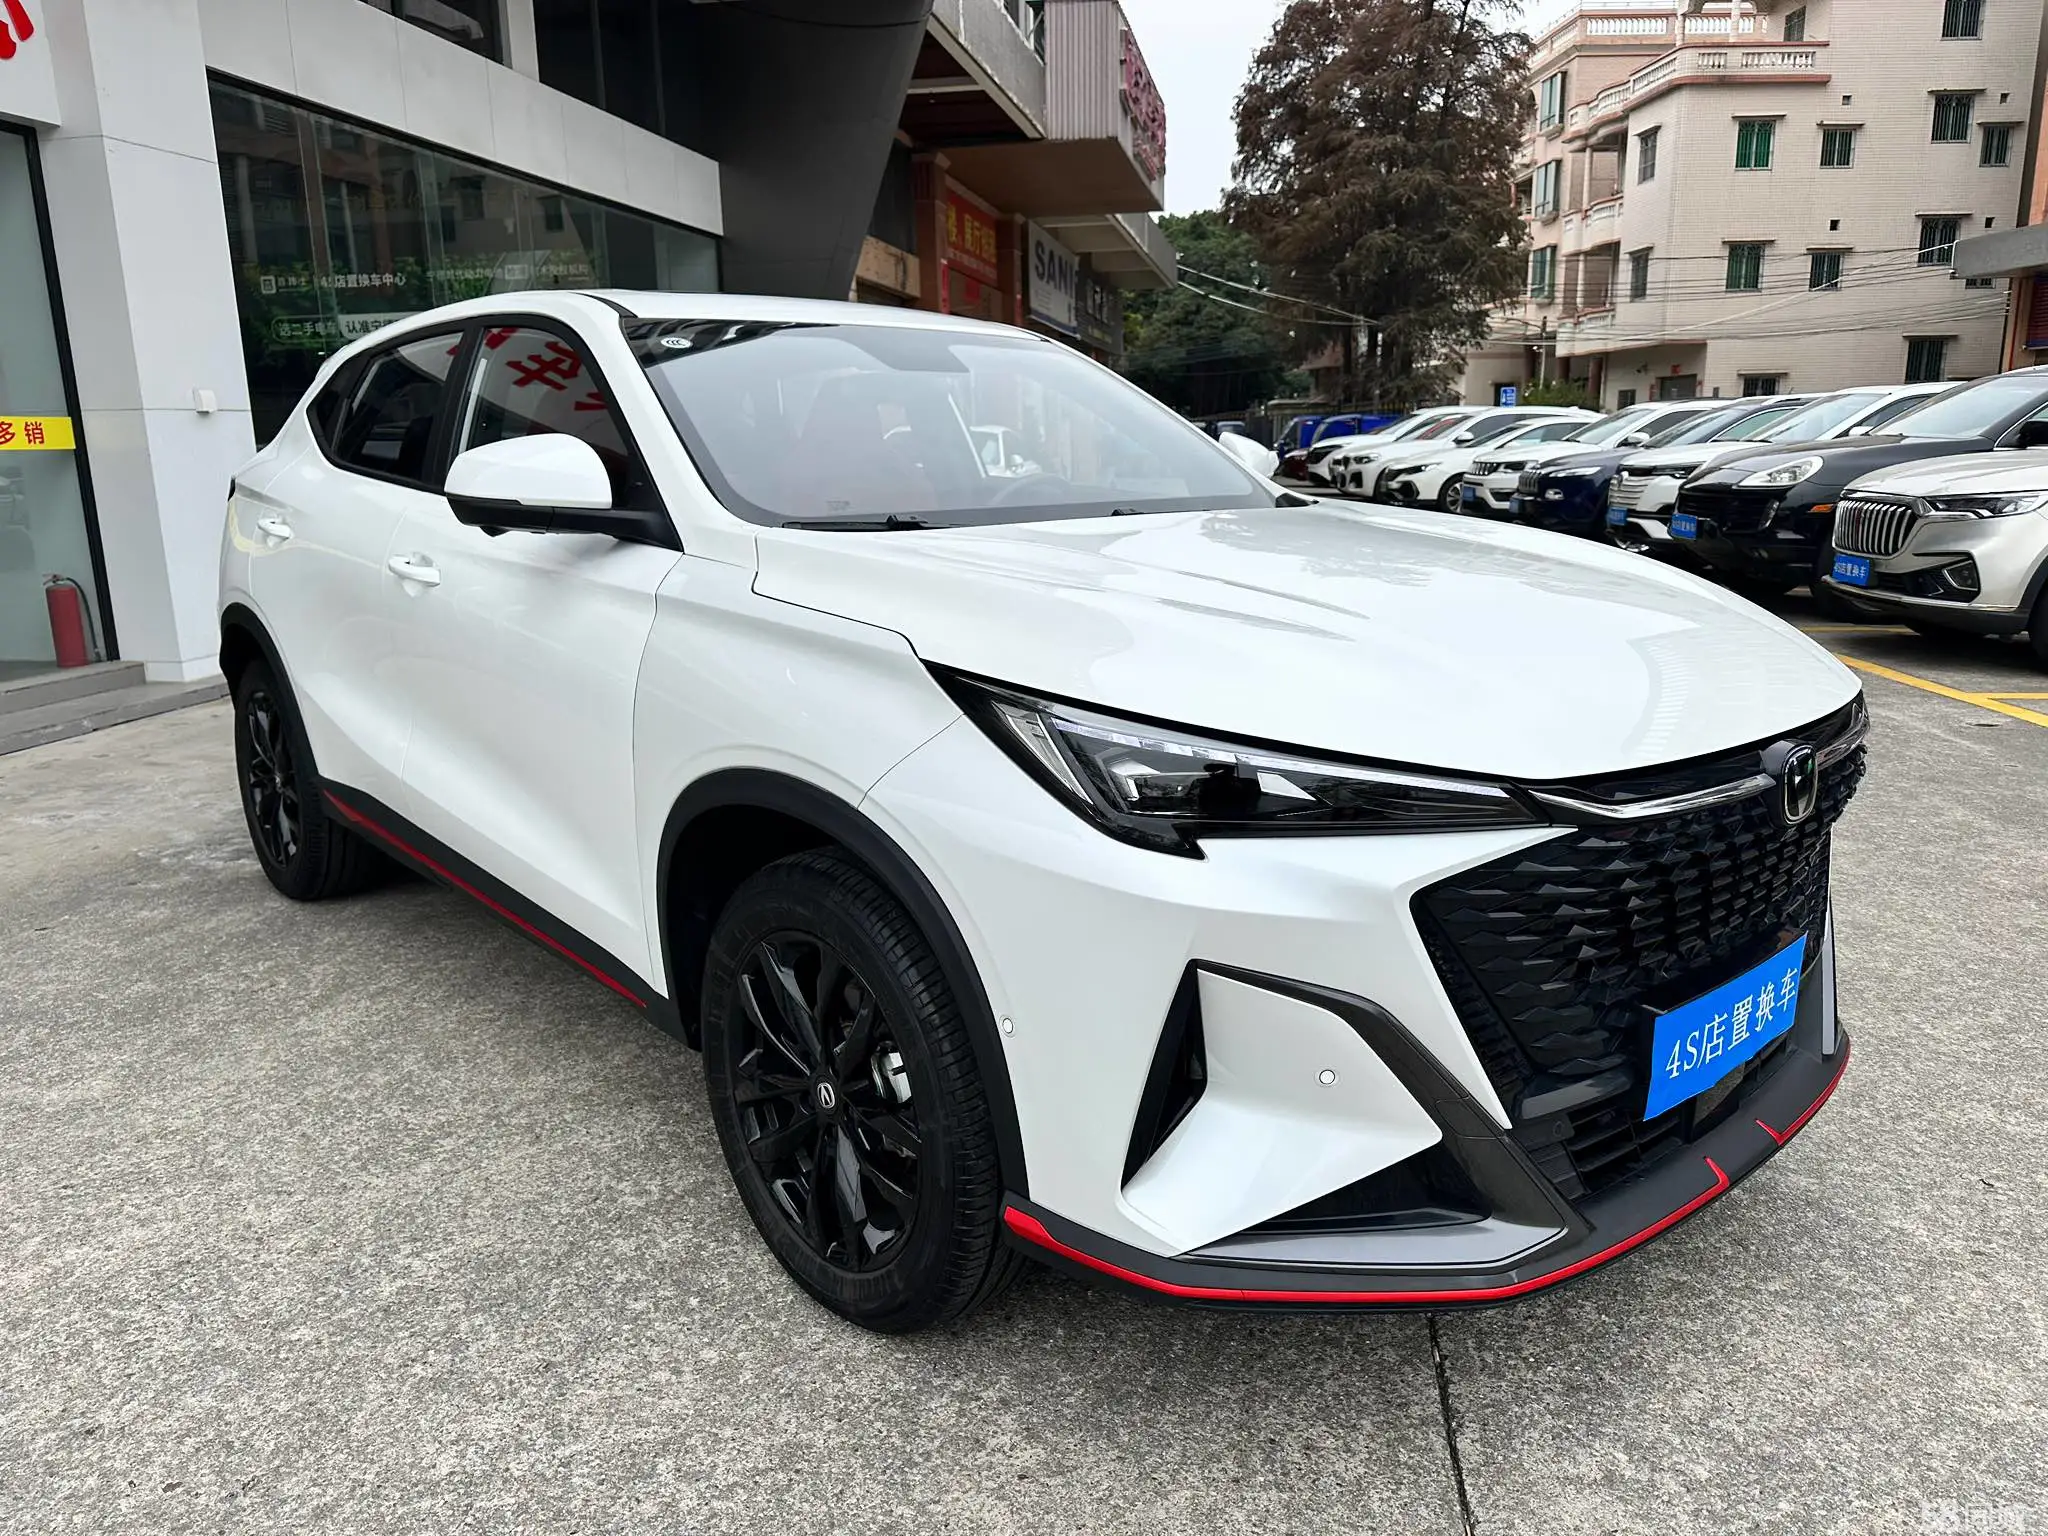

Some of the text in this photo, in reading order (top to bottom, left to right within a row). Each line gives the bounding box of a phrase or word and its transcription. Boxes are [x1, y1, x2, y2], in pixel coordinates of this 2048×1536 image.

[0, 421, 45, 445] 多销
[1665, 967, 1798, 1080] 4S店置换车
